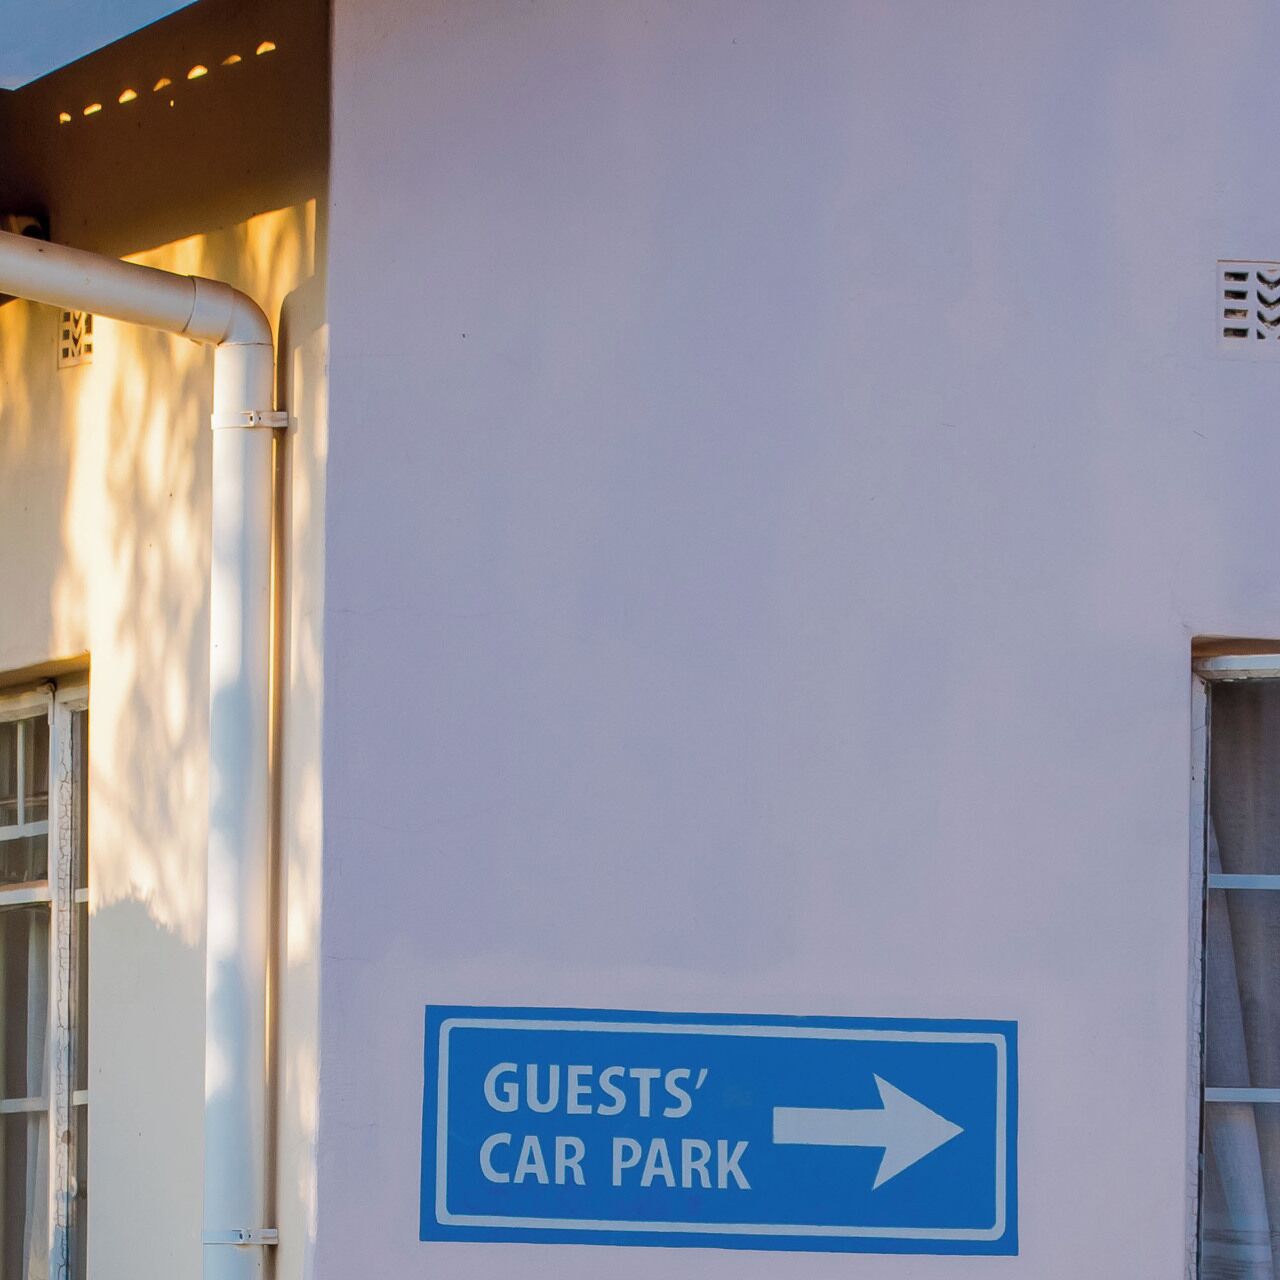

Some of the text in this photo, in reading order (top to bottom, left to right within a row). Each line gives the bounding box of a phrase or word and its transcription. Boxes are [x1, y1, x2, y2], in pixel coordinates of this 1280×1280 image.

[483, 1062, 709, 1118] GUESTS’
[479, 1132, 750, 1190] CAR PARK
